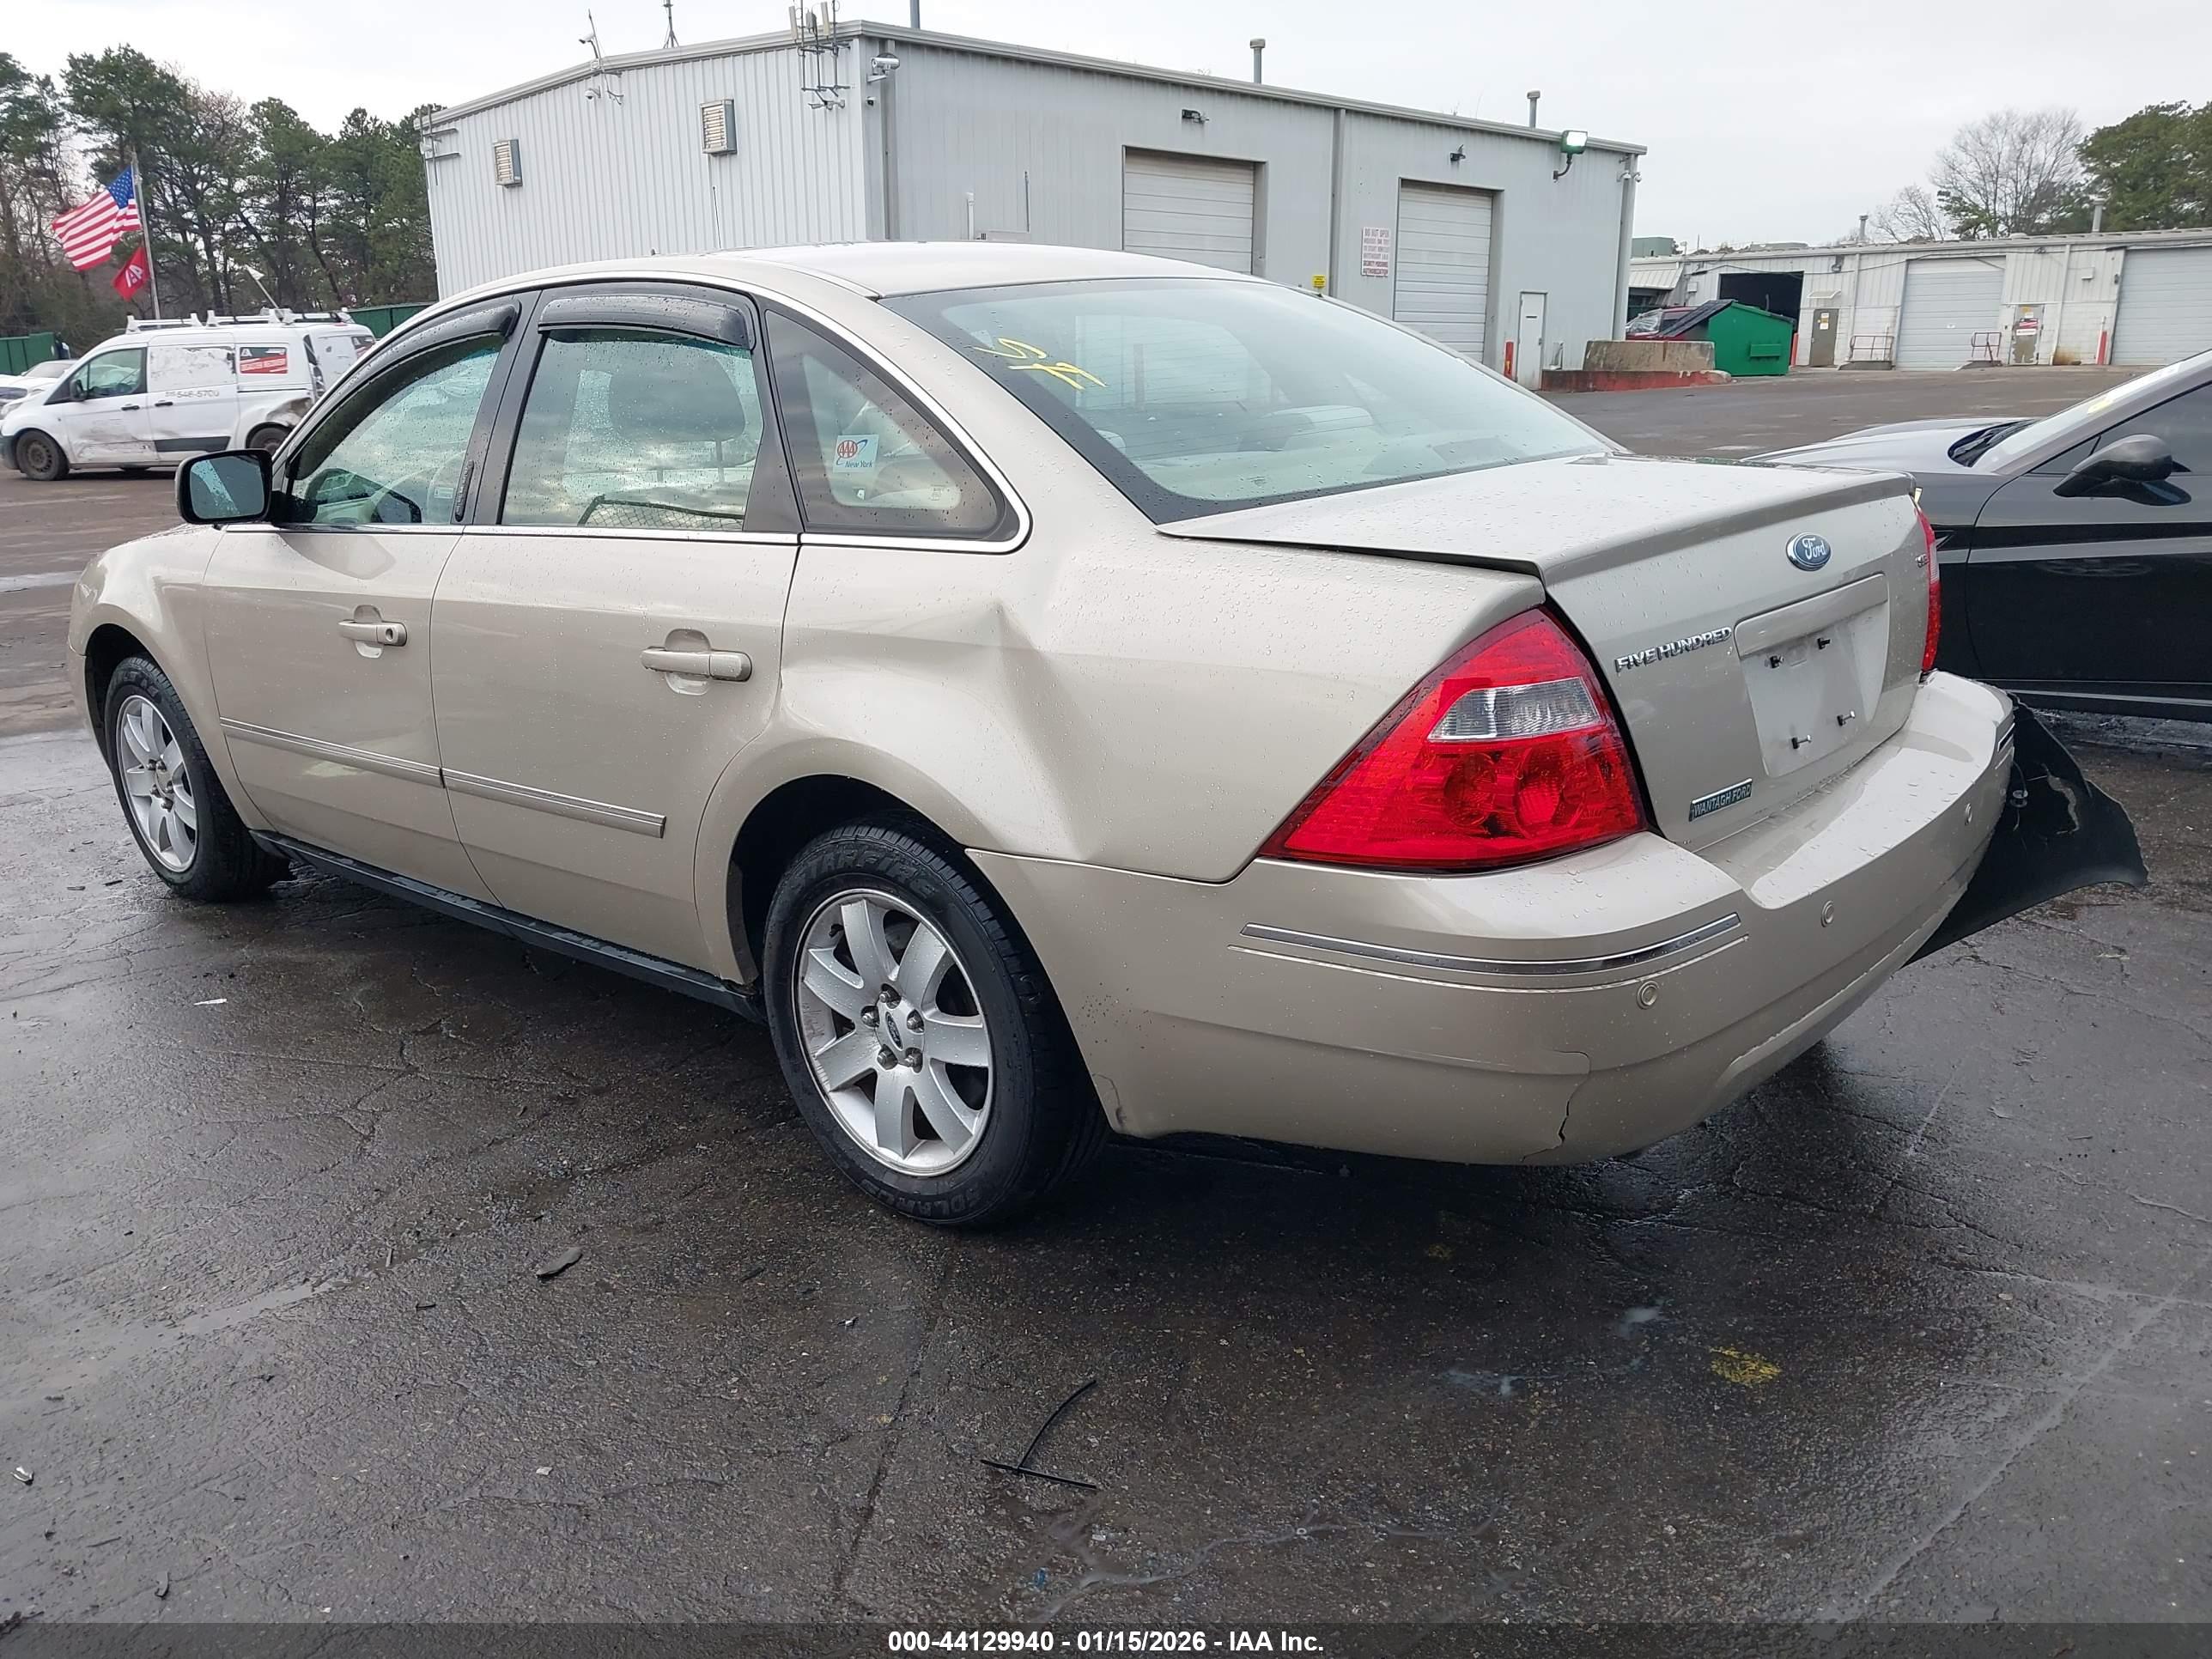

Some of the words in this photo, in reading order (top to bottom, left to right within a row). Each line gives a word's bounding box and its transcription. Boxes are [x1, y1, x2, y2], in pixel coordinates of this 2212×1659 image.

[860, 459, 872, 468] York
[1802, 538, 1827, 560] Ford
[1614, 648, 1656, 672] FIVE
[1656, 626, 1733, 661] HUNDRED
[1693, 790, 1732, 817] WANTAGH
[1731, 784, 1752, 803] FORD
